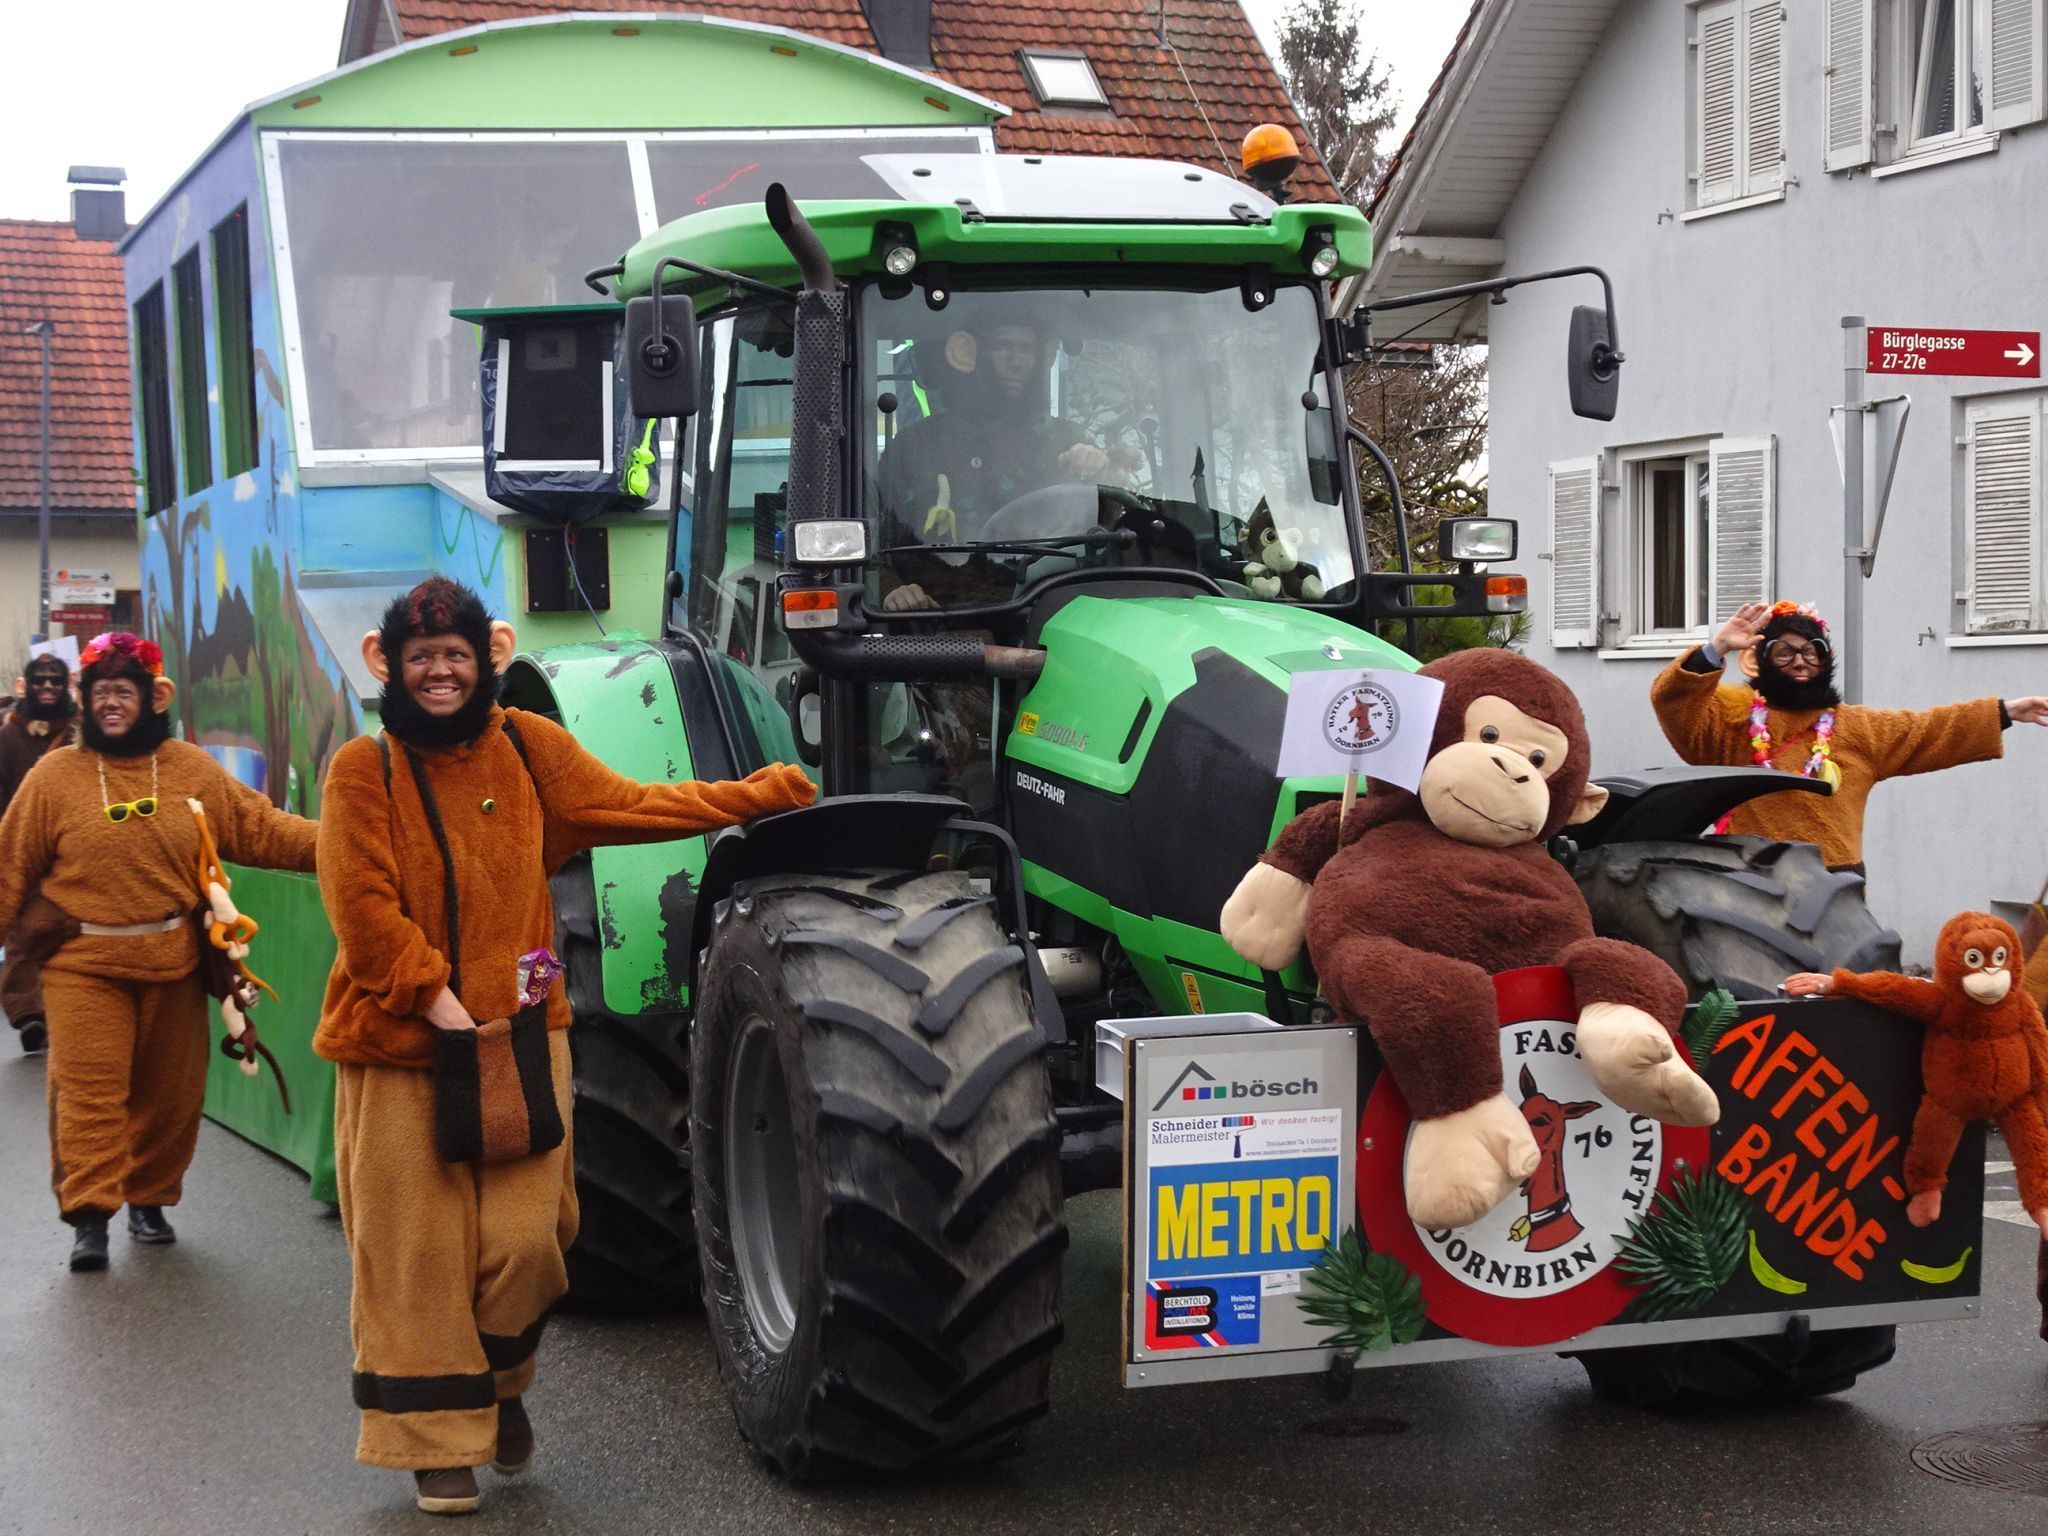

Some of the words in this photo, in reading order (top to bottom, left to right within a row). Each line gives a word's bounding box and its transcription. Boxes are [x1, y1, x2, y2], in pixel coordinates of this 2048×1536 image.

[1883, 332, 1965, 352] Bürglegasse
[1882, 353, 1926, 369] 27-27e
[1329, 695, 1349, 728] HATLER
[1334, 736, 1380, 748] DORNBIRN
[1231, 1077, 1318, 1099] bösch
[1711, 1014, 1905, 1201] AFFEN-
[1152, 1119, 1218, 1132] Schneider
[1152, 1130, 1231, 1145] Malermeister
[1574, 1125, 1613, 1158] 76
[1716, 1123, 1887, 1281] BANDE
[1157, 1175, 1331, 1261] METRO
[1165, 1296, 1208, 1307] BERCHTOLD
[1237, 1312, 1255, 1320] Klima
